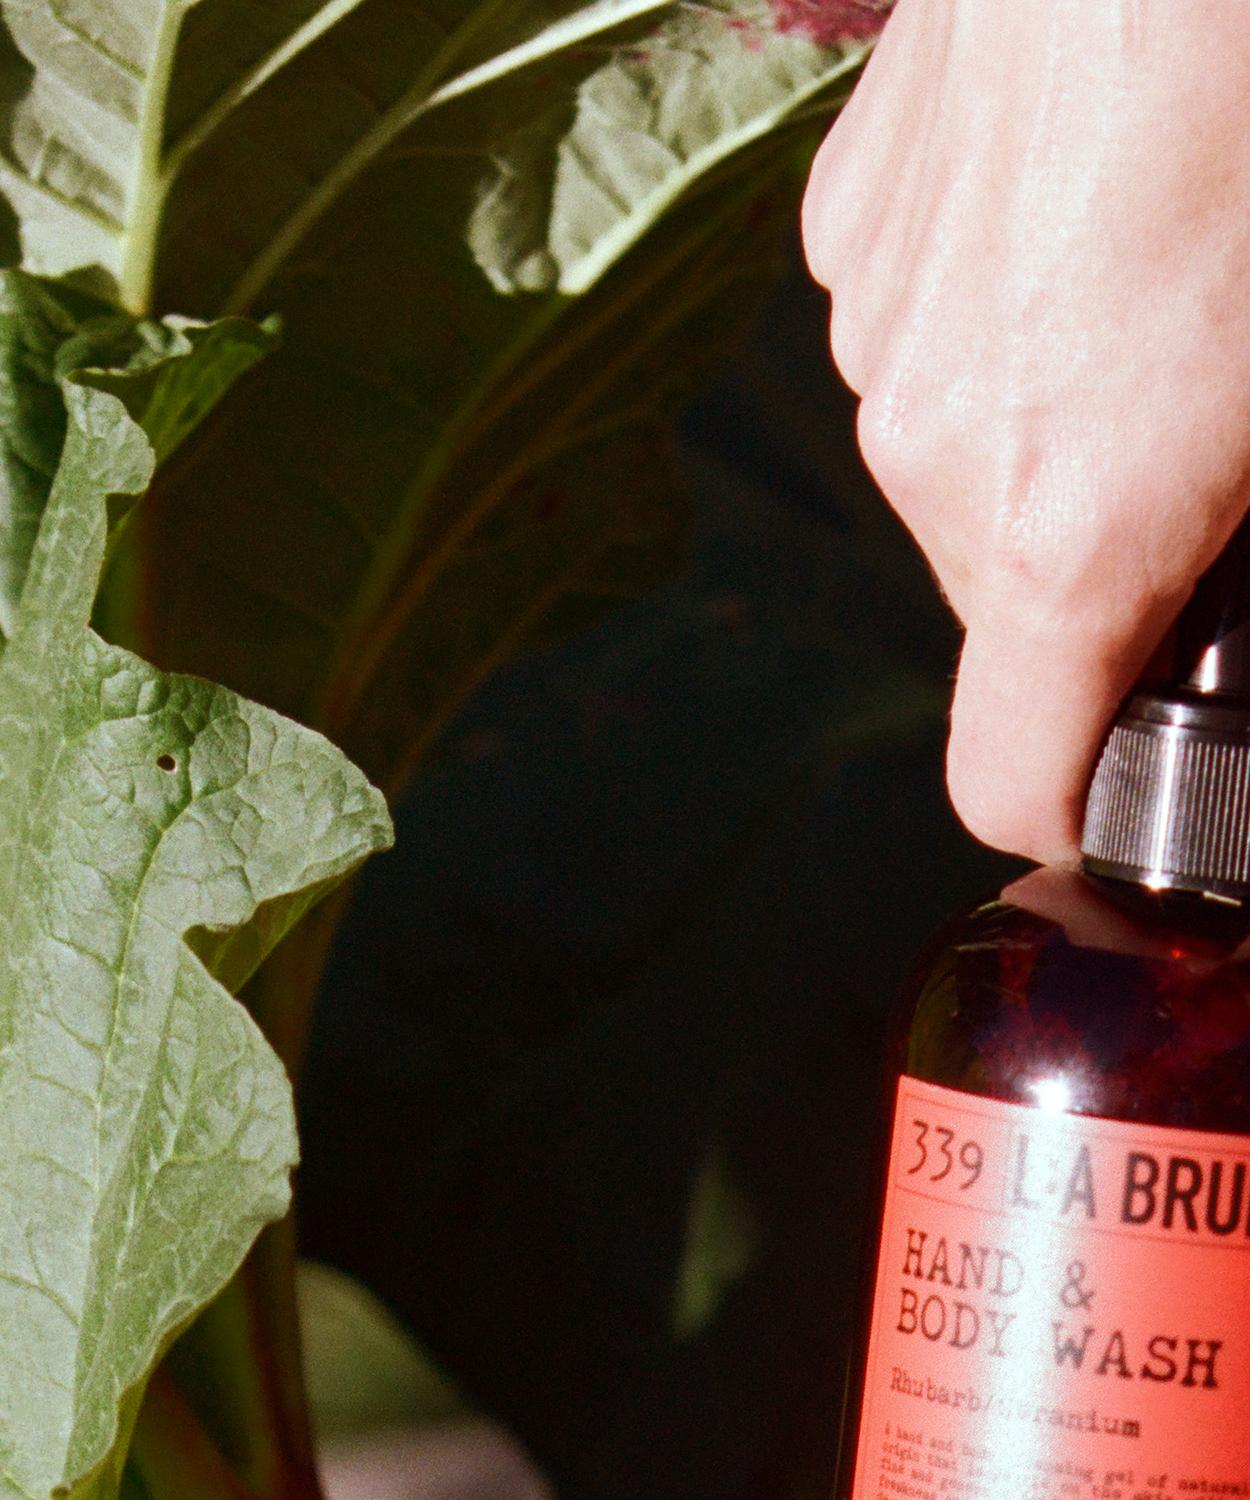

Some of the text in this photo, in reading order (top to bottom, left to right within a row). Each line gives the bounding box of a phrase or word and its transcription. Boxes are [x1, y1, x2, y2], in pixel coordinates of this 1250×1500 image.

[908, 1120, 984, 1192] 339
[904, 1228, 1097, 1308] HAND &
[897, 1286, 1222, 1387] BODY WASH
